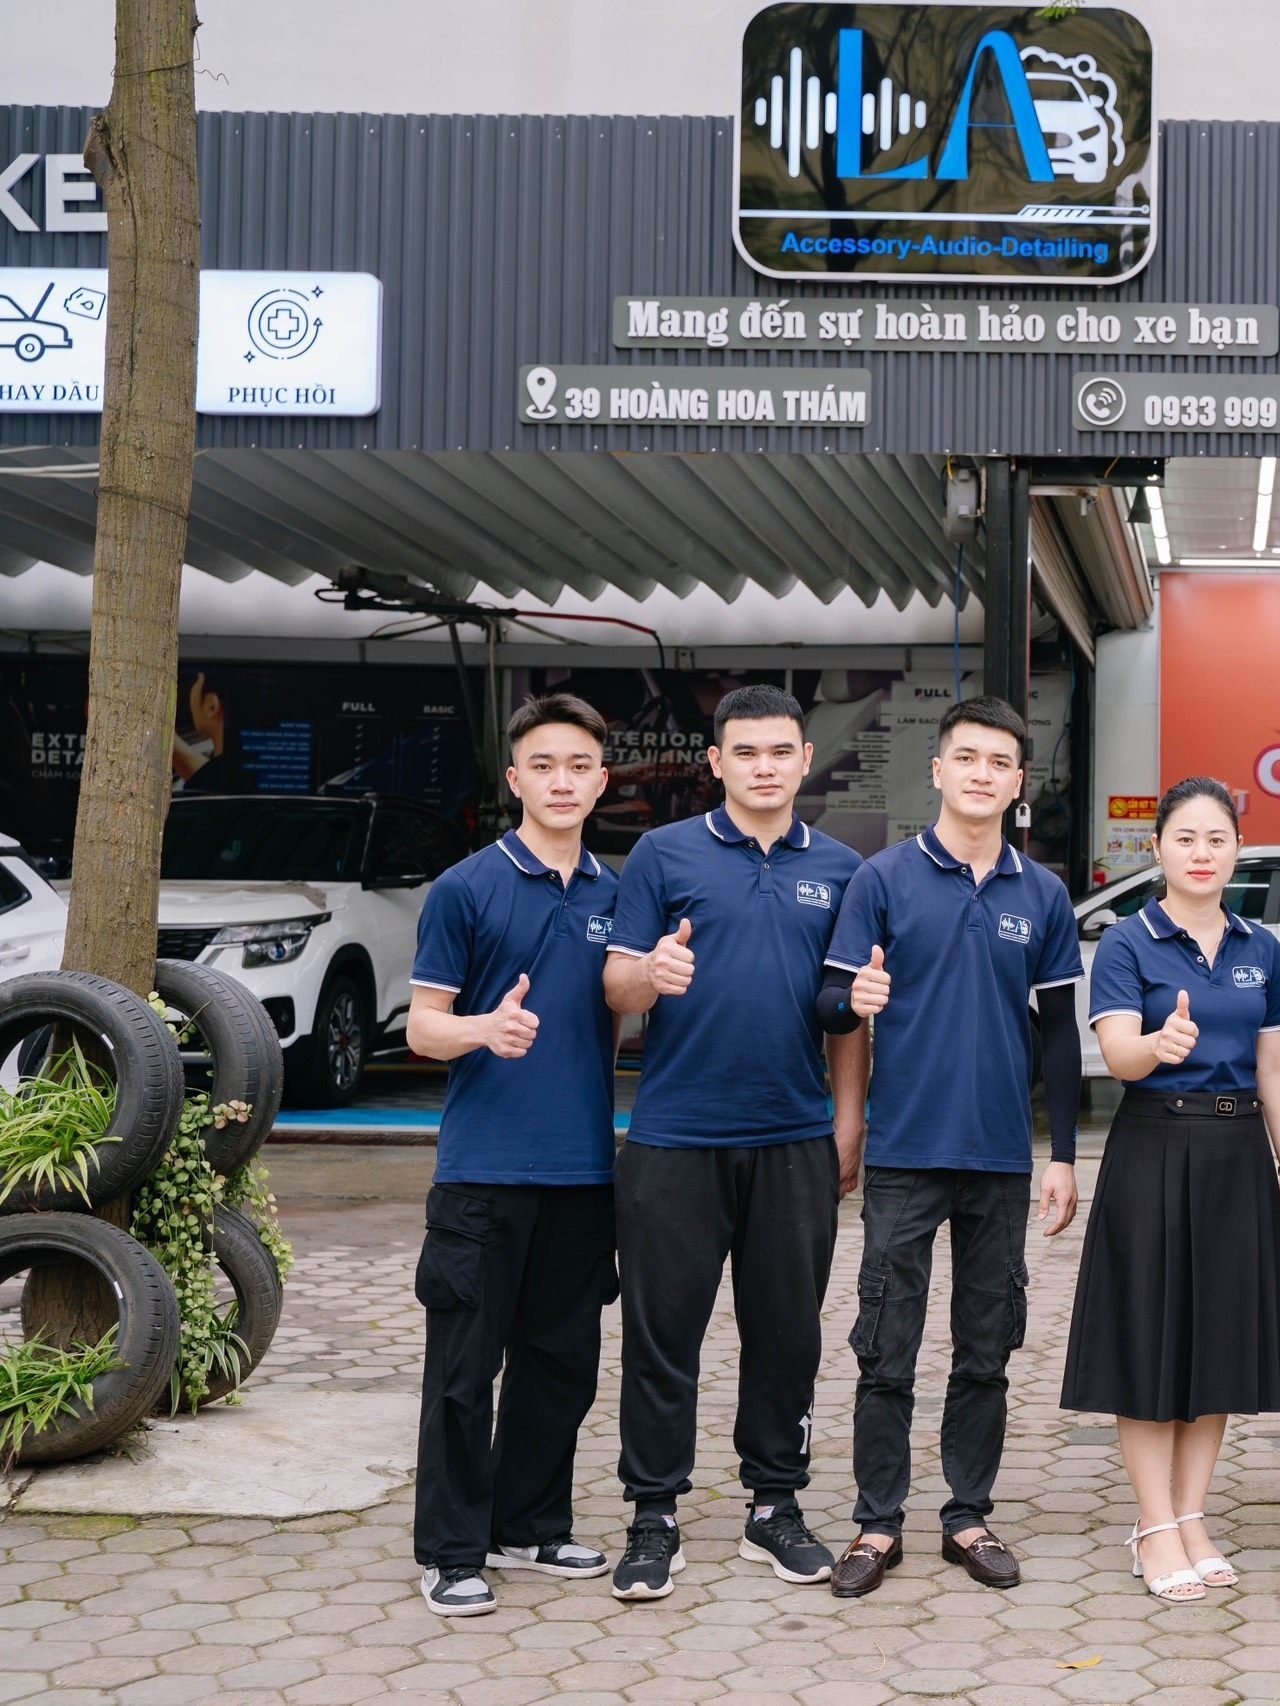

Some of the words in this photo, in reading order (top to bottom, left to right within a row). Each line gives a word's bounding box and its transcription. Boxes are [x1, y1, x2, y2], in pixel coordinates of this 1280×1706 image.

[781, 231, 1109, 264] Accessory-Audio-Detailing
[627, 300, 729, 348] Mang
[739, 299, 806, 340] đến
[819, 307, 864, 346] sự
[875, 302, 967, 342] hoàn
[978, 303, 1046, 343] hảo
[1056, 306, 1121, 343] cho
[1133, 315, 1177, 344] xe
[1188, 308, 1260, 350] bạn
[52, 379, 99, 402] DẦU
[228, 386, 288, 407] PHỤC
[295, 383, 336, 405] HỒI
[564, 387, 601, 418] 39
[610, 381, 709, 420] HOÀNG
[717, 389, 775, 421] HOA
[783, 384, 866, 422] THÁM
[1144, 395, 1216, 427] 0933
[1224, 396, 1277, 428] 999
[914, 688, 951, 698] FULL
[343, 702, 375, 712] FULL
[424, 705, 455, 714] BASIC
